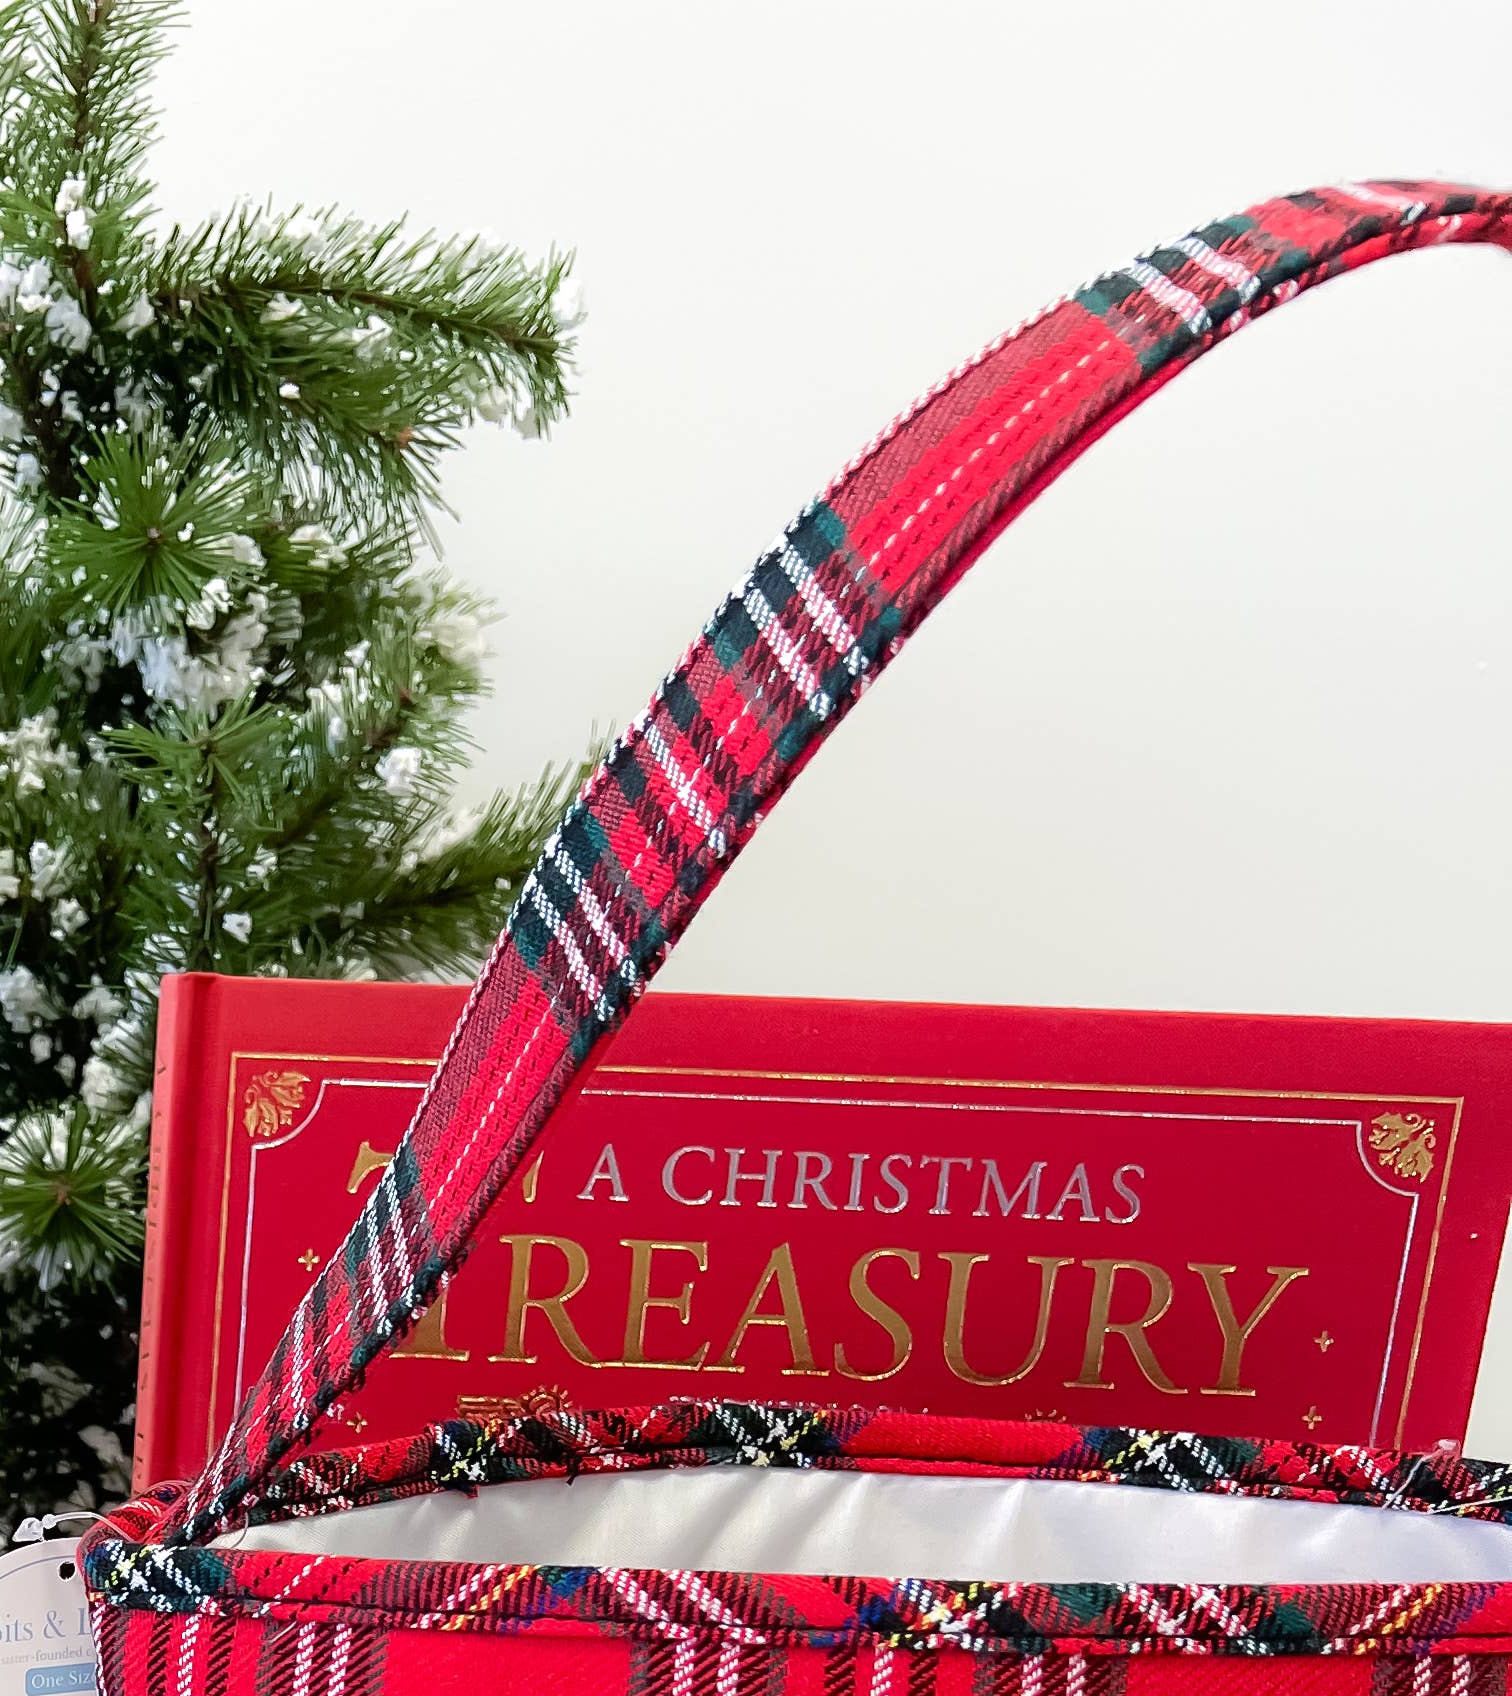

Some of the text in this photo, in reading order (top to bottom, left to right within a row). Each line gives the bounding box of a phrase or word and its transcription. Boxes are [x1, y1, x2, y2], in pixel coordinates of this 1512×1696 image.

[577, 1144, 1145, 1224] A CHRISTMAS
[43, 1610, 65, 1639] &
[31, 1673, 64, 1689] One
